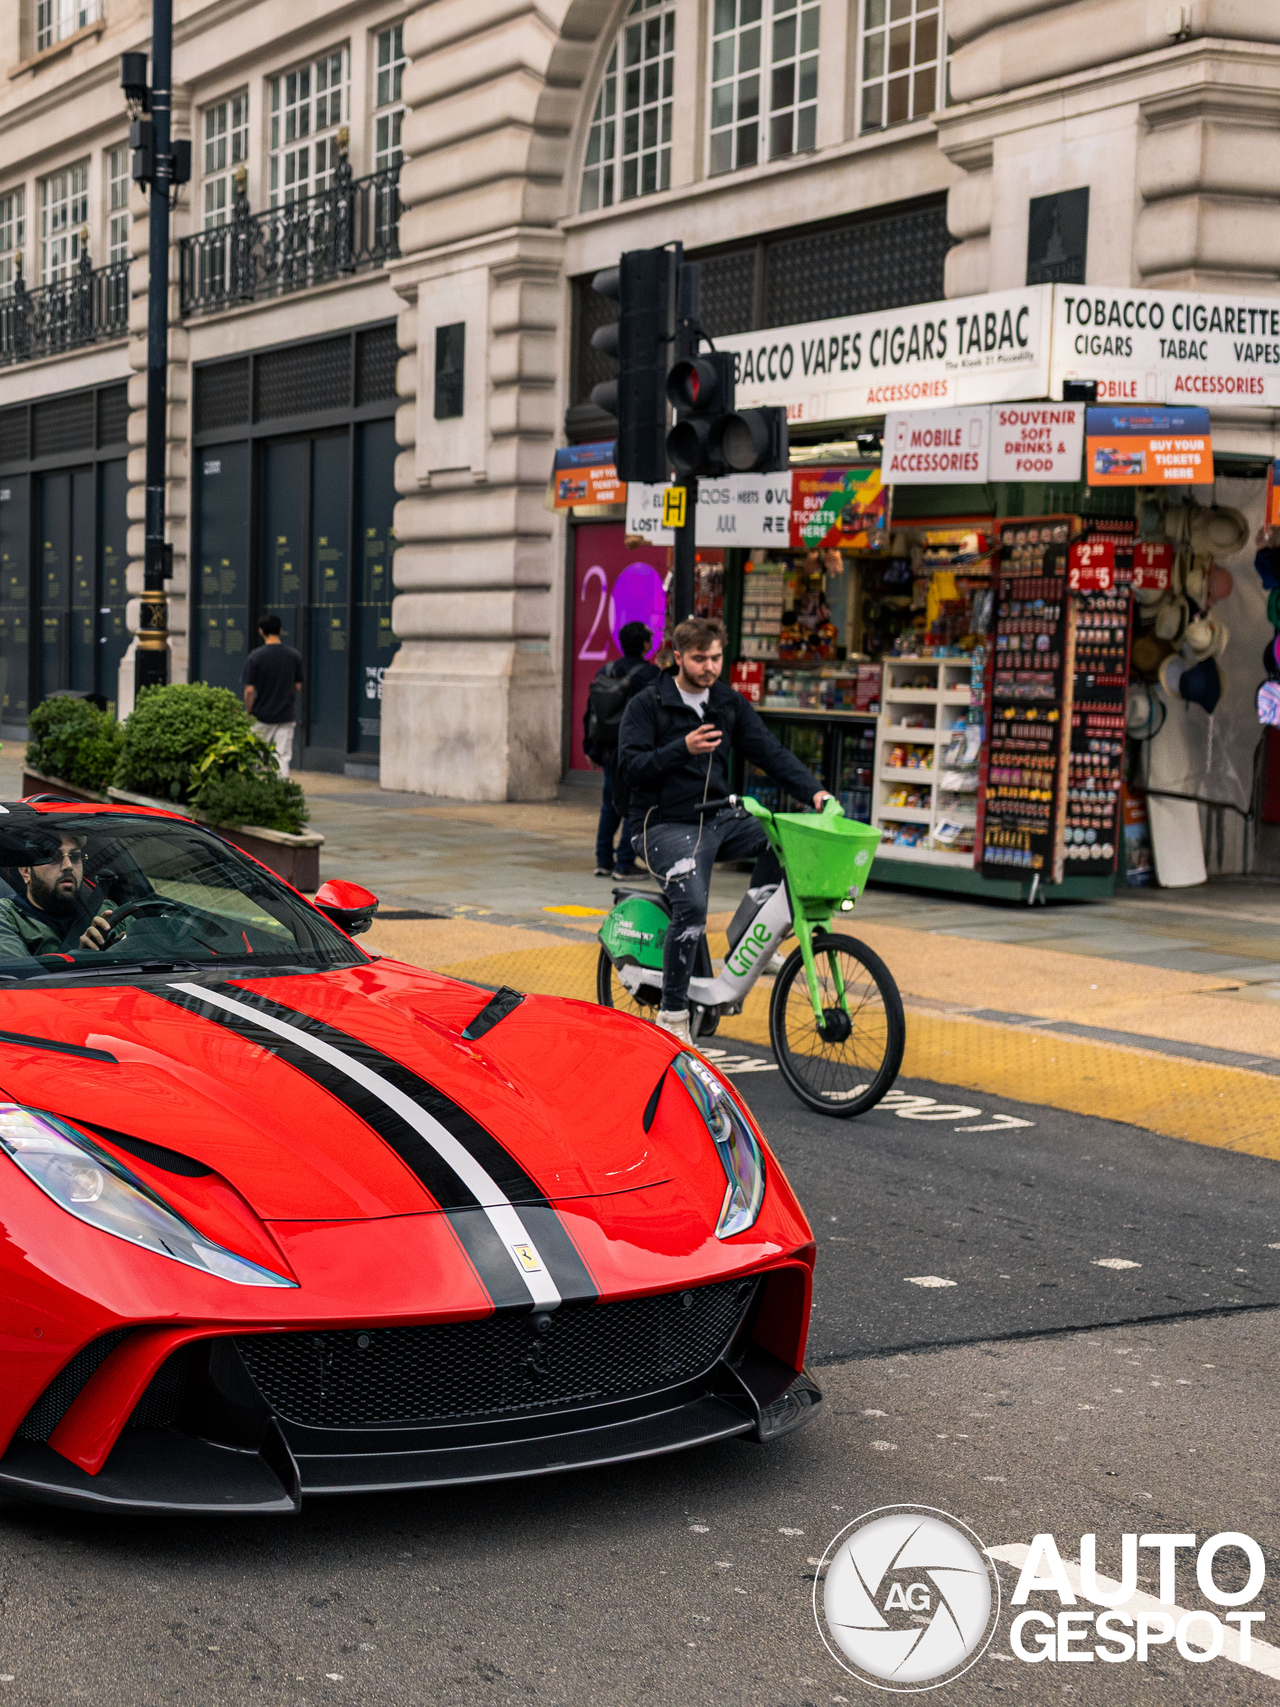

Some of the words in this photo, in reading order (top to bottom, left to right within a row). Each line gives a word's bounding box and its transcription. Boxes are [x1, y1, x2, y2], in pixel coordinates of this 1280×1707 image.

[1064, 298, 1165, 330] TOBACCO
[733, 343, 794, 385] BACCO
[801, 332, 862, 377] VAPES
[870, 319, 948, 369] CIGARS
[956, 304, 1030, 354] TABAC
[1075, 334, 1133, 357] CIGARS
[1159, 338, 1208, 360] TABAC
[1233, 341, 1280, 364] VAPES
[867, 379, 948, 405] ACCESSORIES
[1096, 380, 1138, 398] OBILE
[1175, 375, 1265, 395] ACCESSORIES
[999, 411, 1076, 425] SOUVENIR
[910, 428, 962, 448] MOBILE
[1020, 428, 1051, 440] SOFT
[1005, 441, 1053, 455] DRINKS
[1057, 441, 1066, 454] &
[1150, 440, 1173, 451] BUY
[1174, 440, 1205, 451] YOUR
[890, 452, 980, 472] ACCESSORIES
[1016, 458, 1054, 472] FOOD
[1155, 454, 1201, 465] TICKETS
[1164, 468, 1194, 479] HERE
[666, 491, 683, 522] H
[803, 496, 826, 509] BUY
[793, 511, 836, 524] TICKETS
[632, 518, 659, 532] LOST
[800, 525, 827, 538] HERE
[1069, 567, 1080, 590] 2
